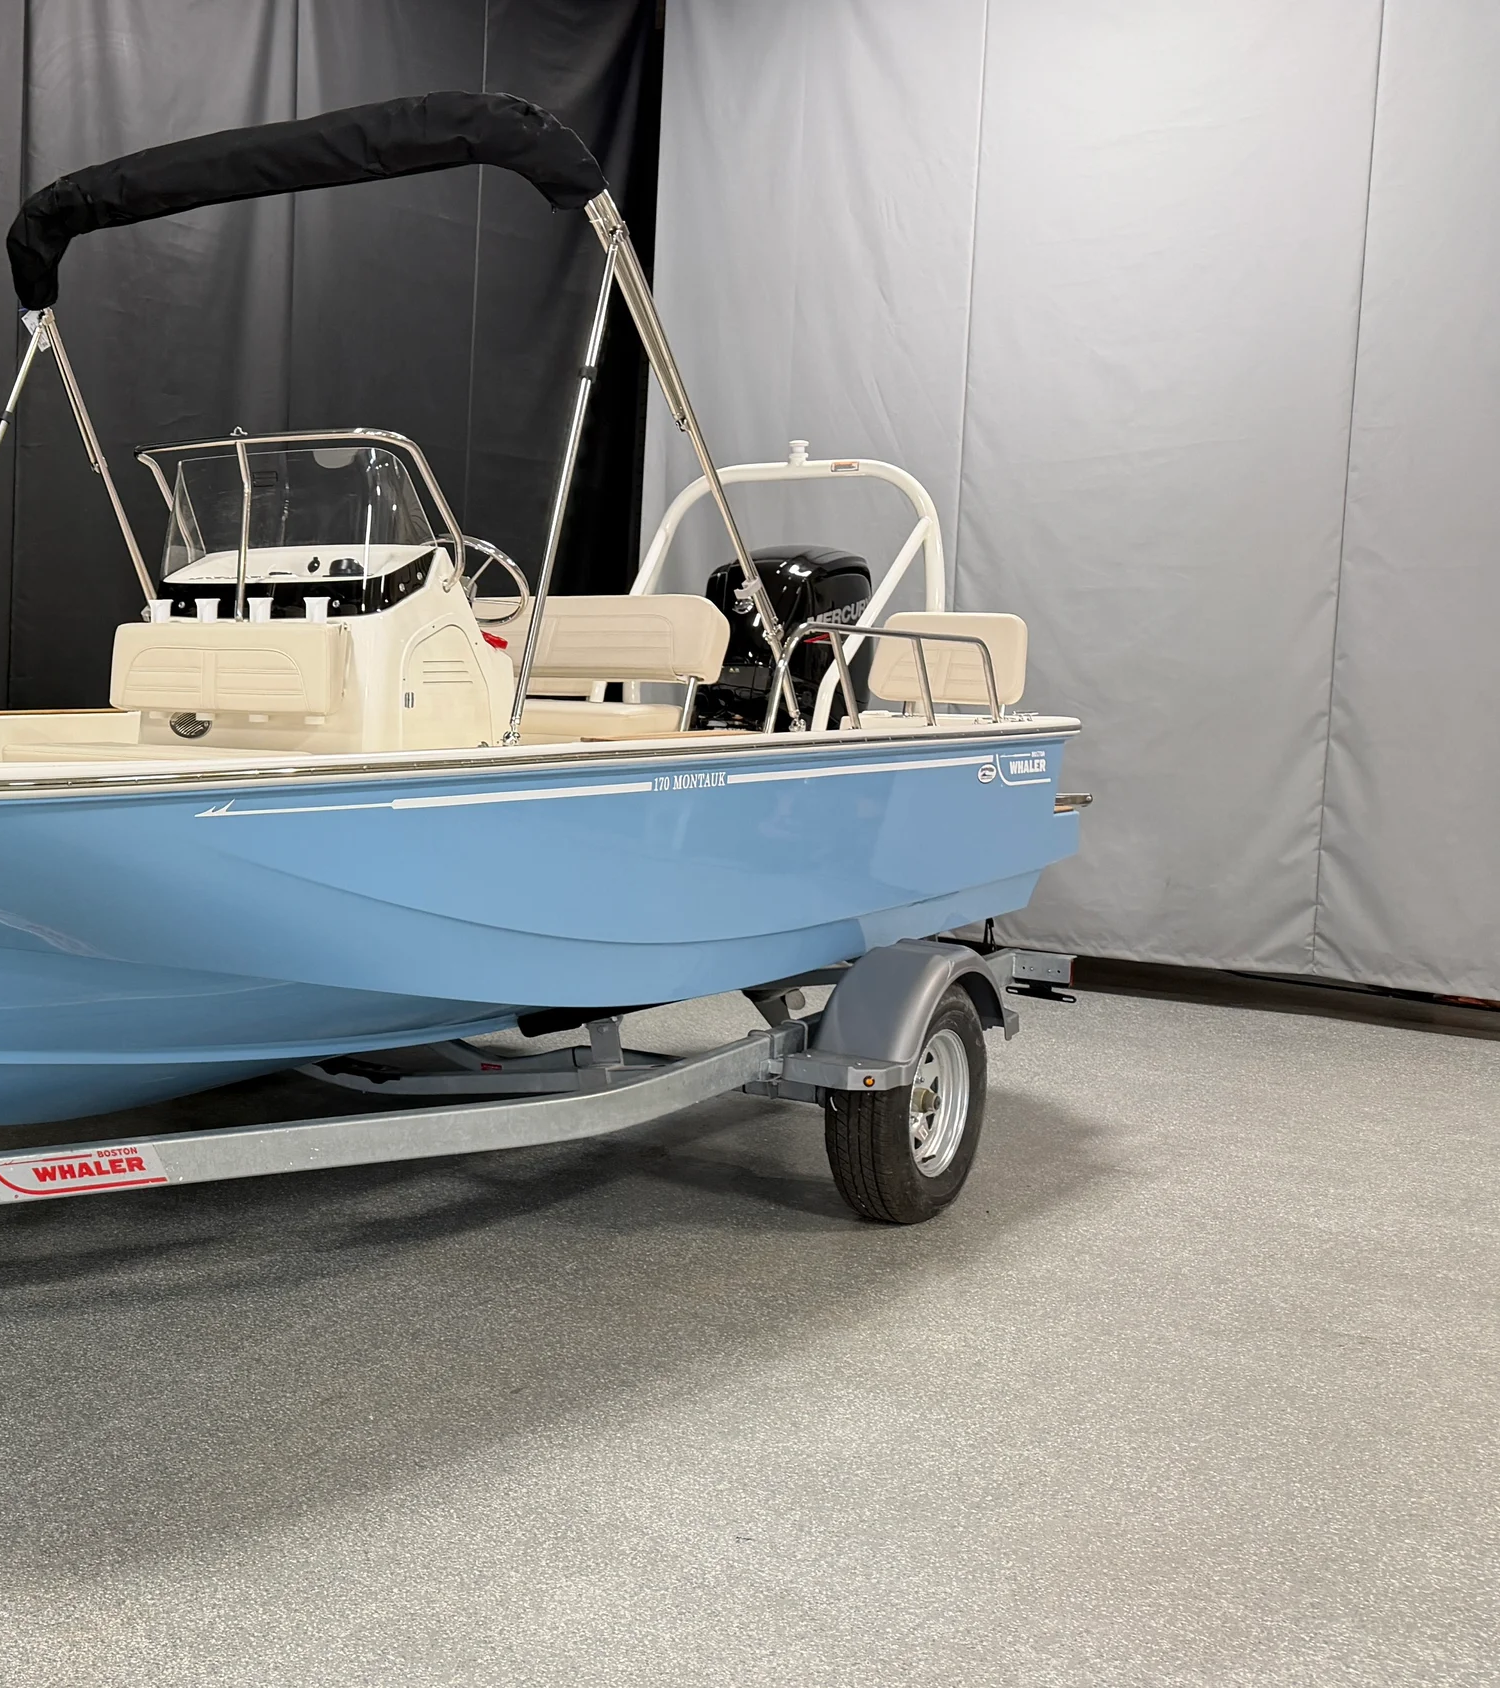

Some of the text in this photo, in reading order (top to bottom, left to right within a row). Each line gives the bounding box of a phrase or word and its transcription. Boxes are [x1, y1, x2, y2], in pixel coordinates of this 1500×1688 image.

[807, 597, 871, 624] MERCUR
[1009, 759, 1046, 774] WHALER
[653, 772, 726, 791] 170 MONTAUK
[97, 1147, 138, 1158] BOSTON
[32, 1156, 147, 1182] WHALER
